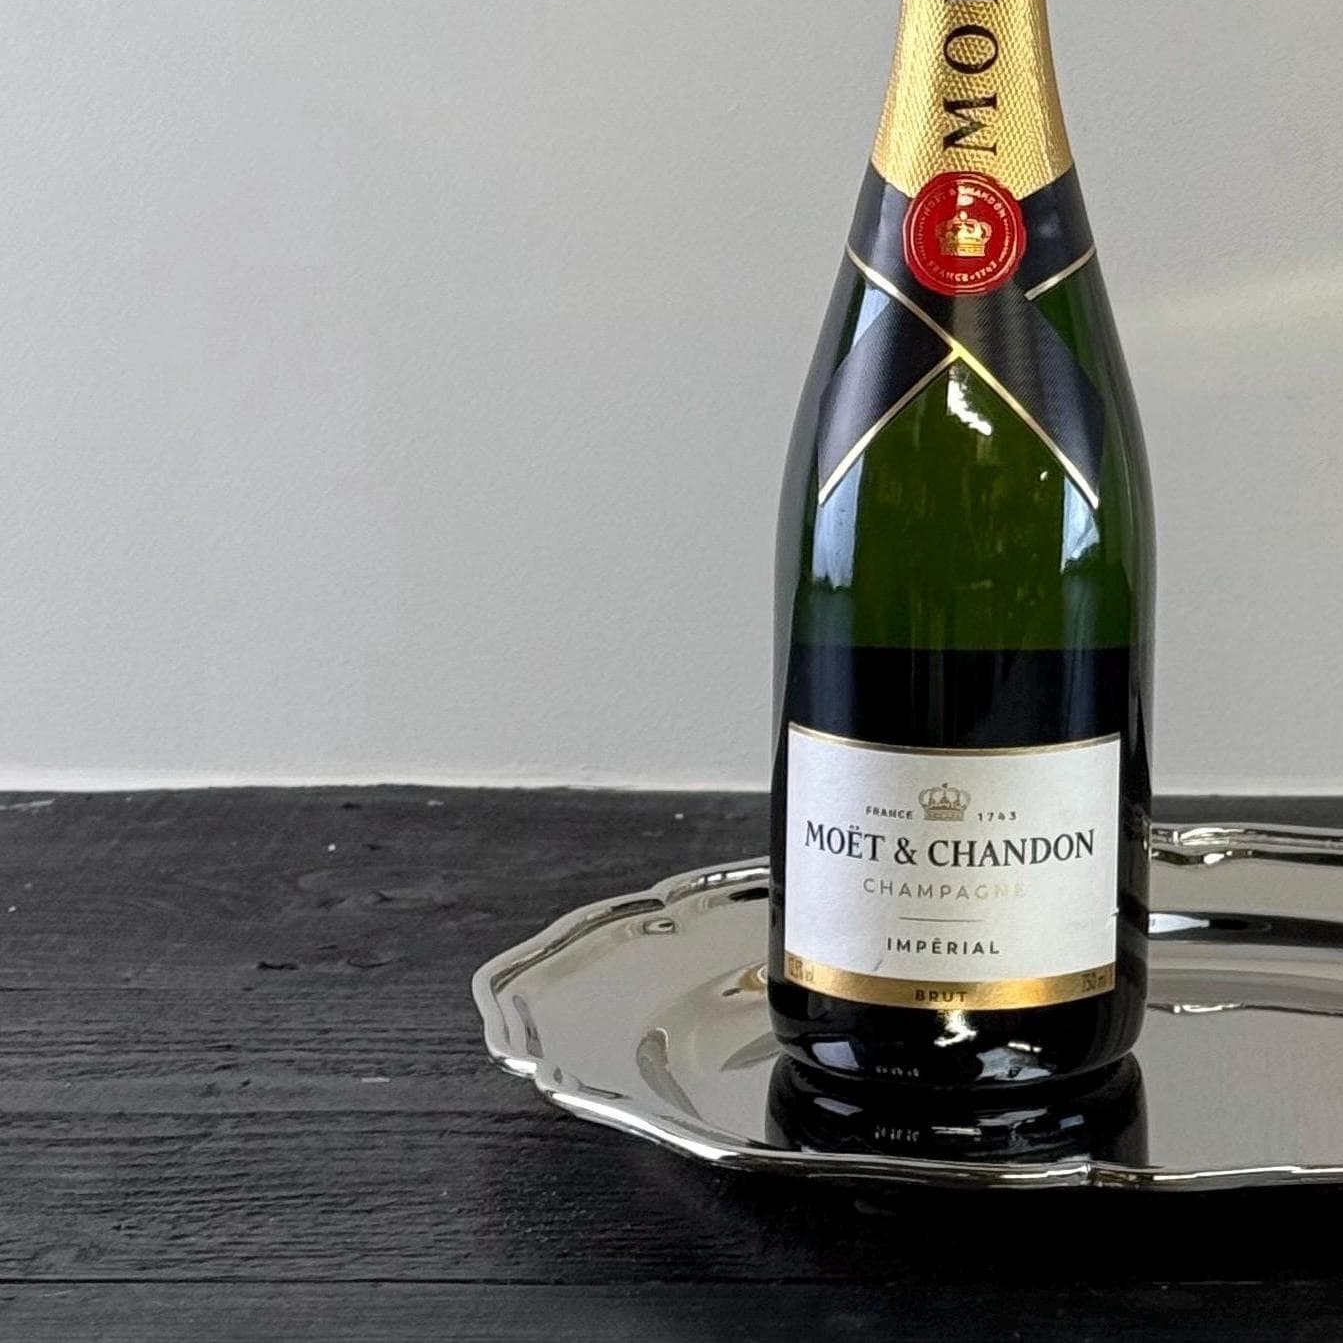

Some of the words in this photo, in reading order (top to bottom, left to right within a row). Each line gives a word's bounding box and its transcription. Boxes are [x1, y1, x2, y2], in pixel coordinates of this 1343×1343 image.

[957, 186, 1007, 219] HANDON
[865, 805, 914, 821] FRANCE
[977, 811, 1018, 823] 1743
[804, 820, 886, 862] MOËT
[893, 837, 918, 867] &
[927, 828, 1096, 868] CHANDON
[862, 877, 1027, 901] CHAMPAGNE
[886, 936, 1001, 956] IMPÉRIAL
[914, 989, 969, 1003] BRUT
